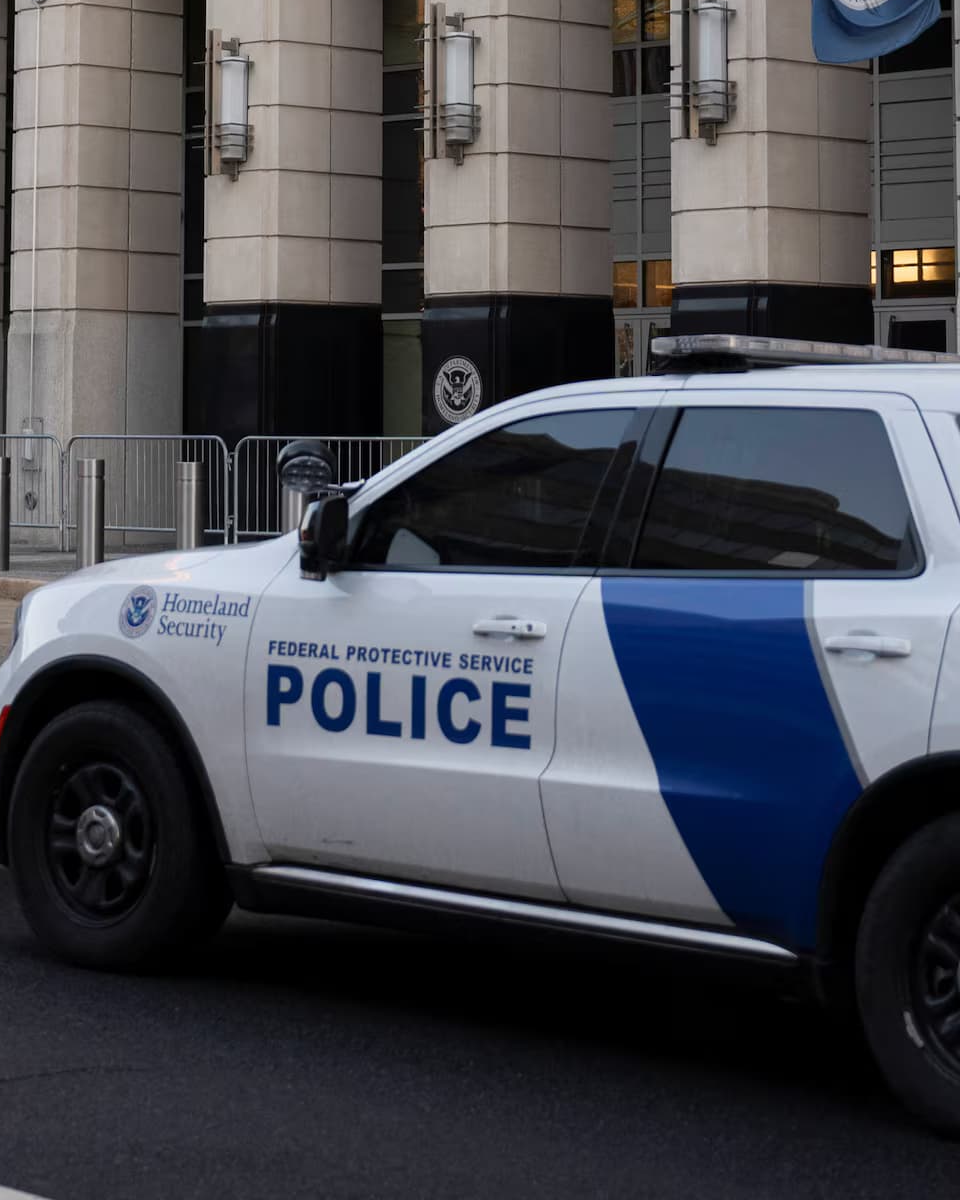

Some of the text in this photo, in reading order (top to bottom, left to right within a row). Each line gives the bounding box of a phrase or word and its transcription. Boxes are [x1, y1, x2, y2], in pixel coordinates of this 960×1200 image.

[161, 592, 251, 617] Homeland
[156, 614, 228, 647] Security
[268, 640, 534, 675] FEDERAL PROTECTIVE SERVICE
[266, 663, 531, 750] POLICE
